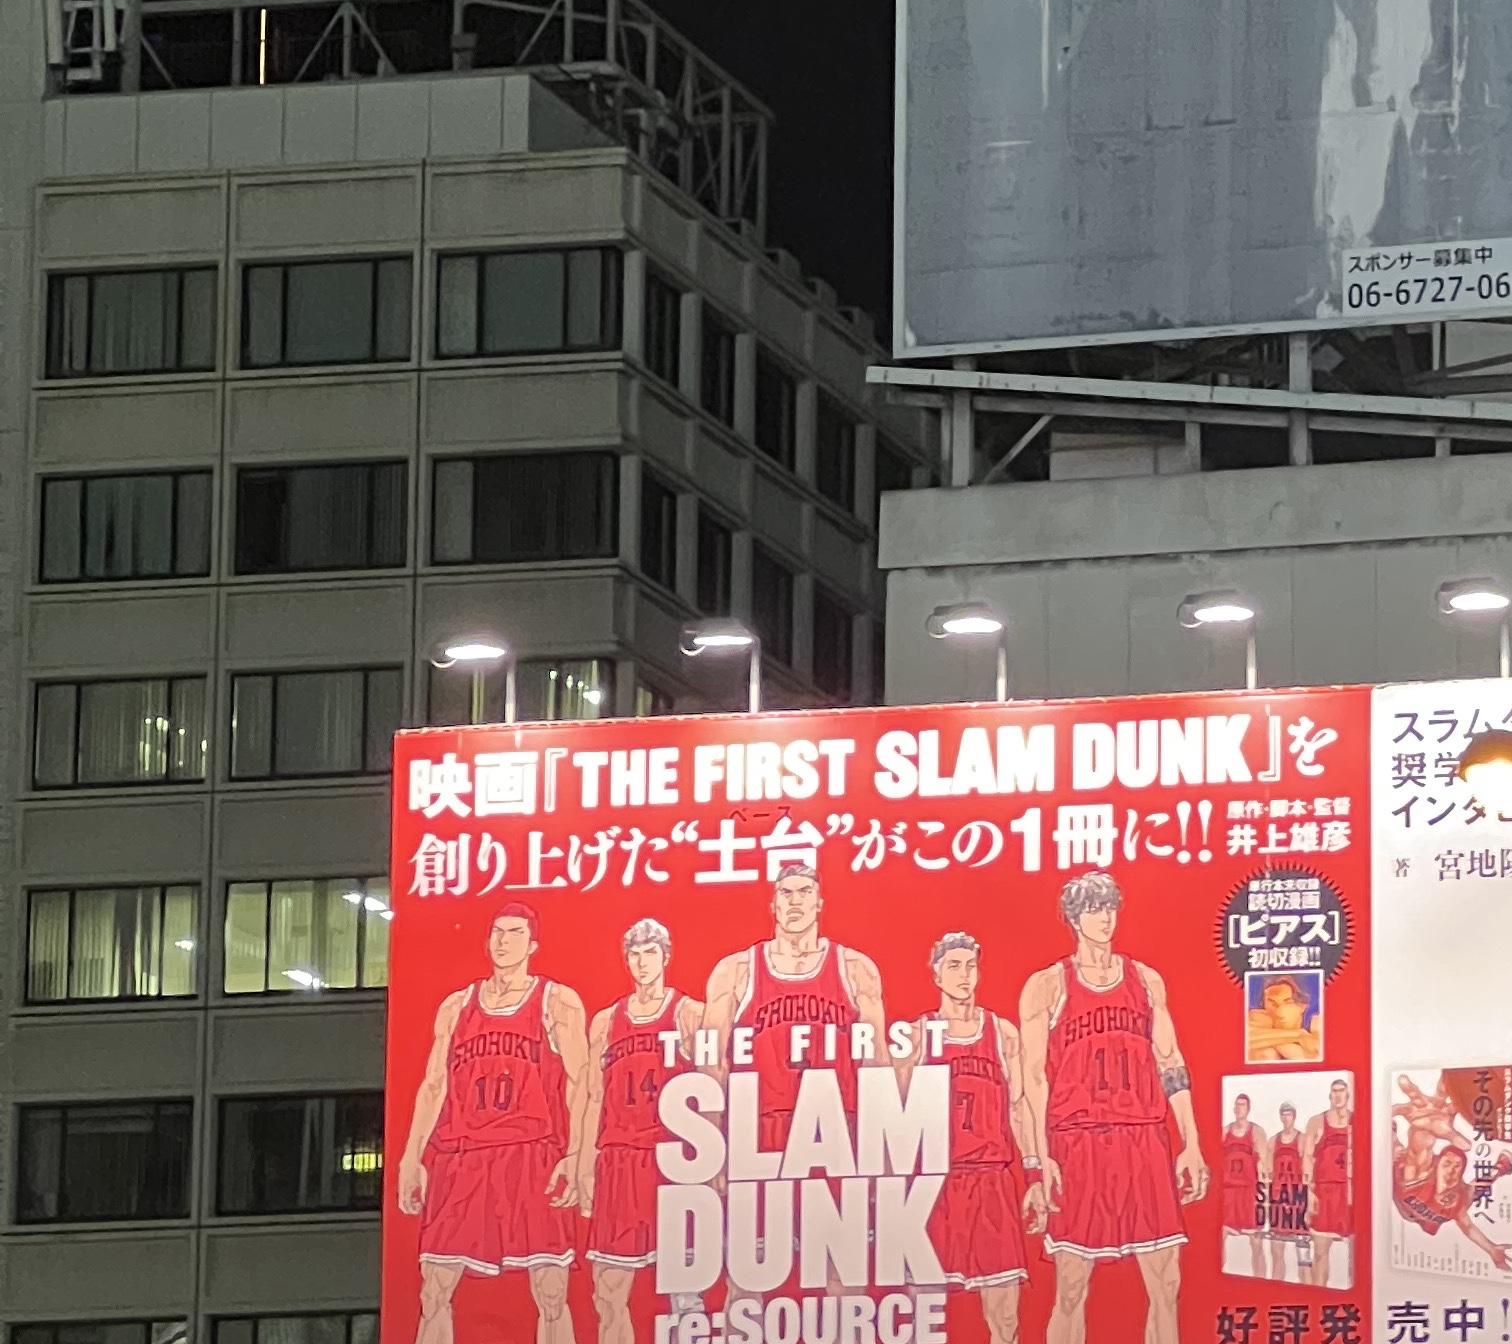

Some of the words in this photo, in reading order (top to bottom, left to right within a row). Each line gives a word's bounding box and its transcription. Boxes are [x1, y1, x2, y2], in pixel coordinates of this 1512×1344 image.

[1348, 246, 1493, 274] スポンサー募集中
[694, 738, 857, 803] FIRST
[874, 720, 1056, 799] SLAM
[1226, 821, 1352, 856] 井上雄彦
[658, 1026, 754, 1068] THE
[790, 1020, 949, 1063] FIRST
[474, 1072, 514, 1112] 10
[956, 1091, 975, 1132] 7
[655, 1064, 951, 1185] SLAM
[1255, 1181, 1308, 1205] SLAM
[655, 1174, 948, 1295] DUNK
